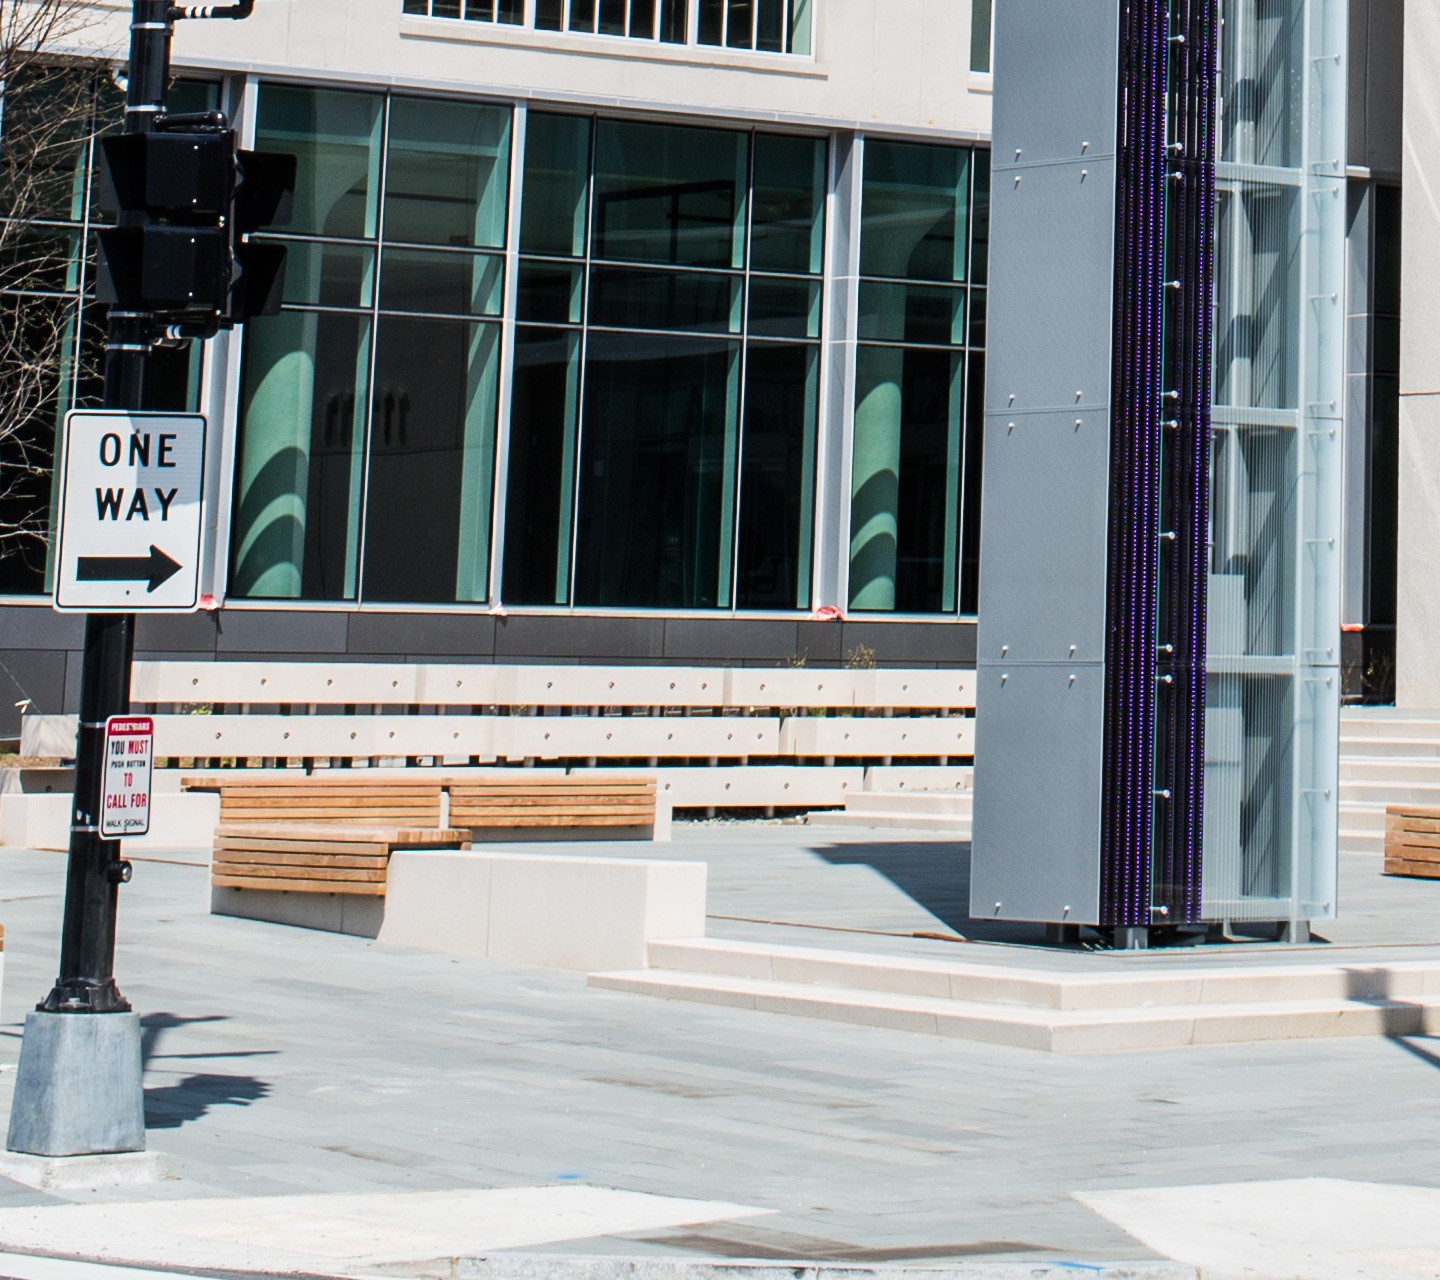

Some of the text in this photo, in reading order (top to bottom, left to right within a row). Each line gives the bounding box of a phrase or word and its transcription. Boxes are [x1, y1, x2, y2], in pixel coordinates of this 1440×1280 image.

[99, 432, 177, 468] ONE
[95, 487, 179, 522] WAY
[111, 740, 149, 755] YOU MUST
[123, 772, 133, 787] TO
[106, 793, 147, 809] CALL FOR
